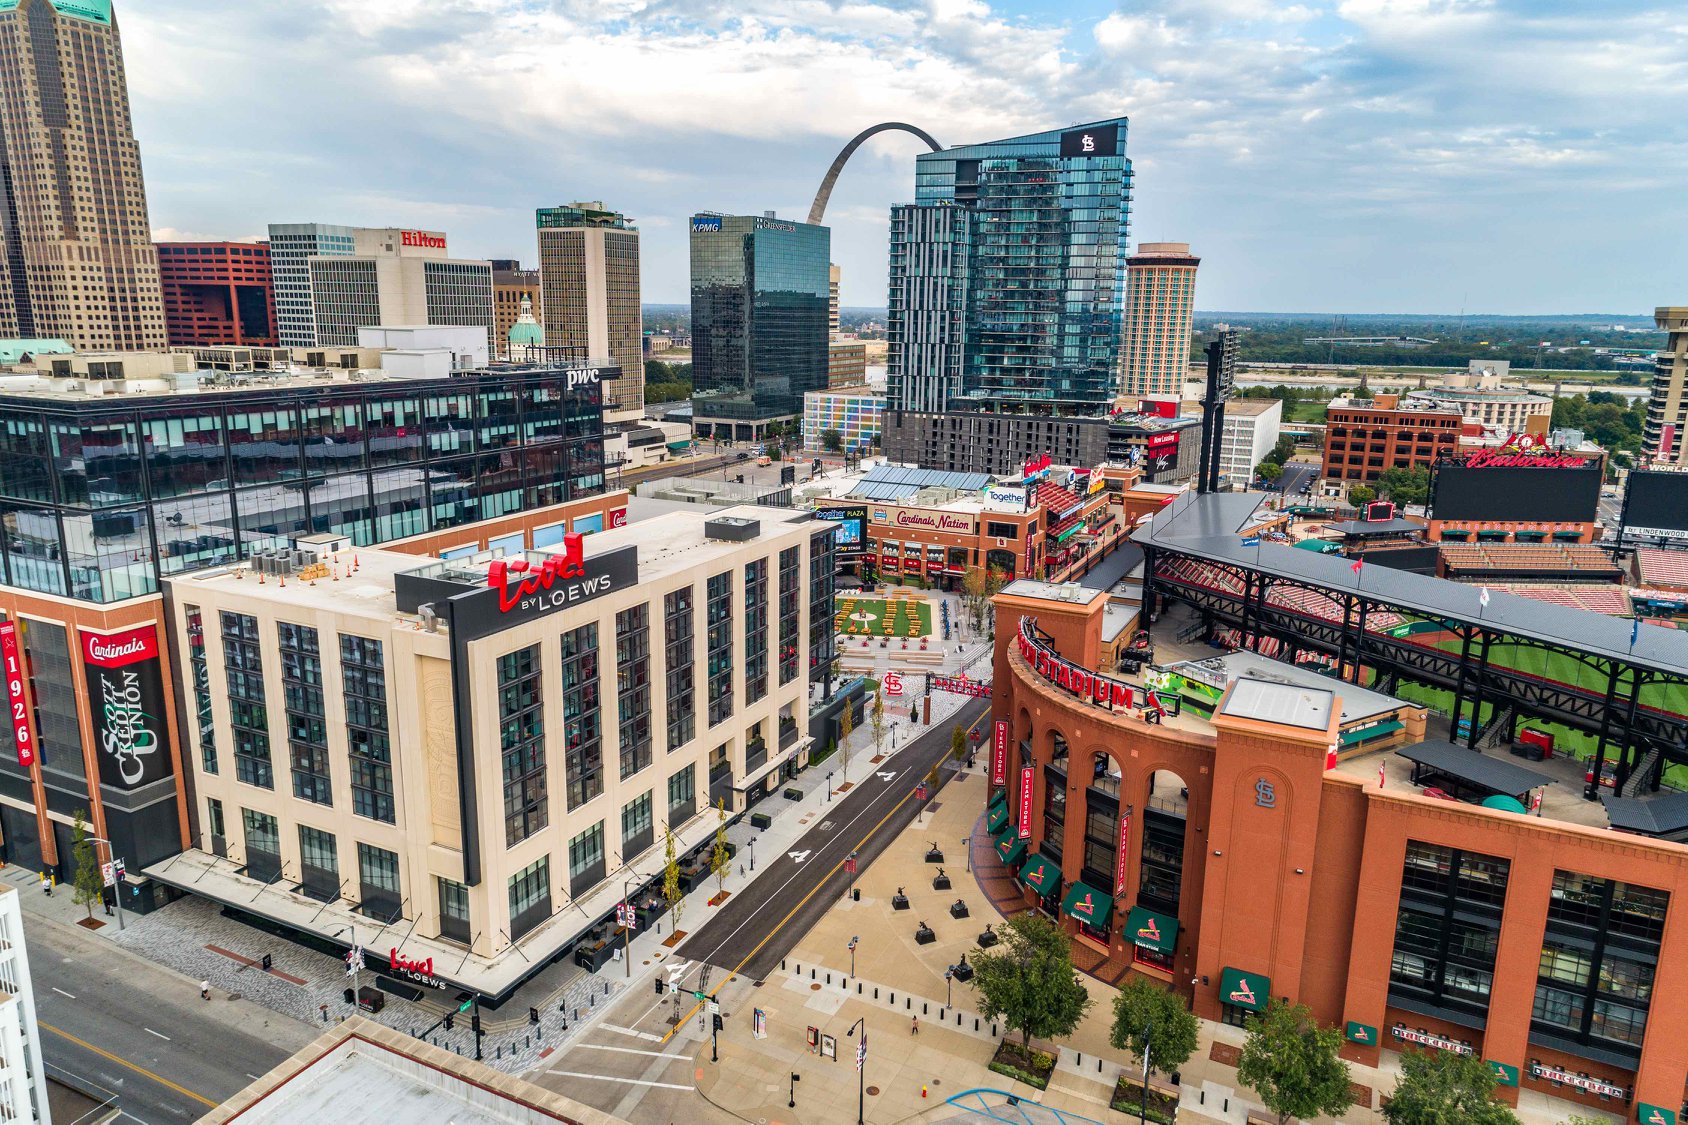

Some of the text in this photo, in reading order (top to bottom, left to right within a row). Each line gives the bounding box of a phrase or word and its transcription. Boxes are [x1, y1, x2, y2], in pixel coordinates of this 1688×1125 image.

[401, 230, 446, 249] Hilton
[692, 223, 719, 232] KPMG
[565, 368, 600, 391] pwc
[1463, 448, 1586, 469] Budweiser
[1649, 464, 1688, 473] WORLD
[989, 490, 1025, 502] Together
[896, 510, 935, 526] Cardinals
[935, 515, 969, 530] Nation
[1639, 528, 1686, 538] LINDENWOOD
[488, 532, 585, 613] Live!
[521, 574, 611, 611] BY LOEWS
[89, 637, 146, 661] Cardinals
[1038, 650, 1133, 710] STADIUM
[7, 656, 29, 743] 1926
[101, 673, 121, 754] SCOTT
[122, 670, 158, 757] UNION
[112, 686, 144, 785] CREDIT
[390, 947, 434, 977] Live!
[407, 971, 446, 990] LOEWS
[1401, 1029, 1463, 1053] TICKETS
[1543, 1069, 1612, 1096] TICKETS
